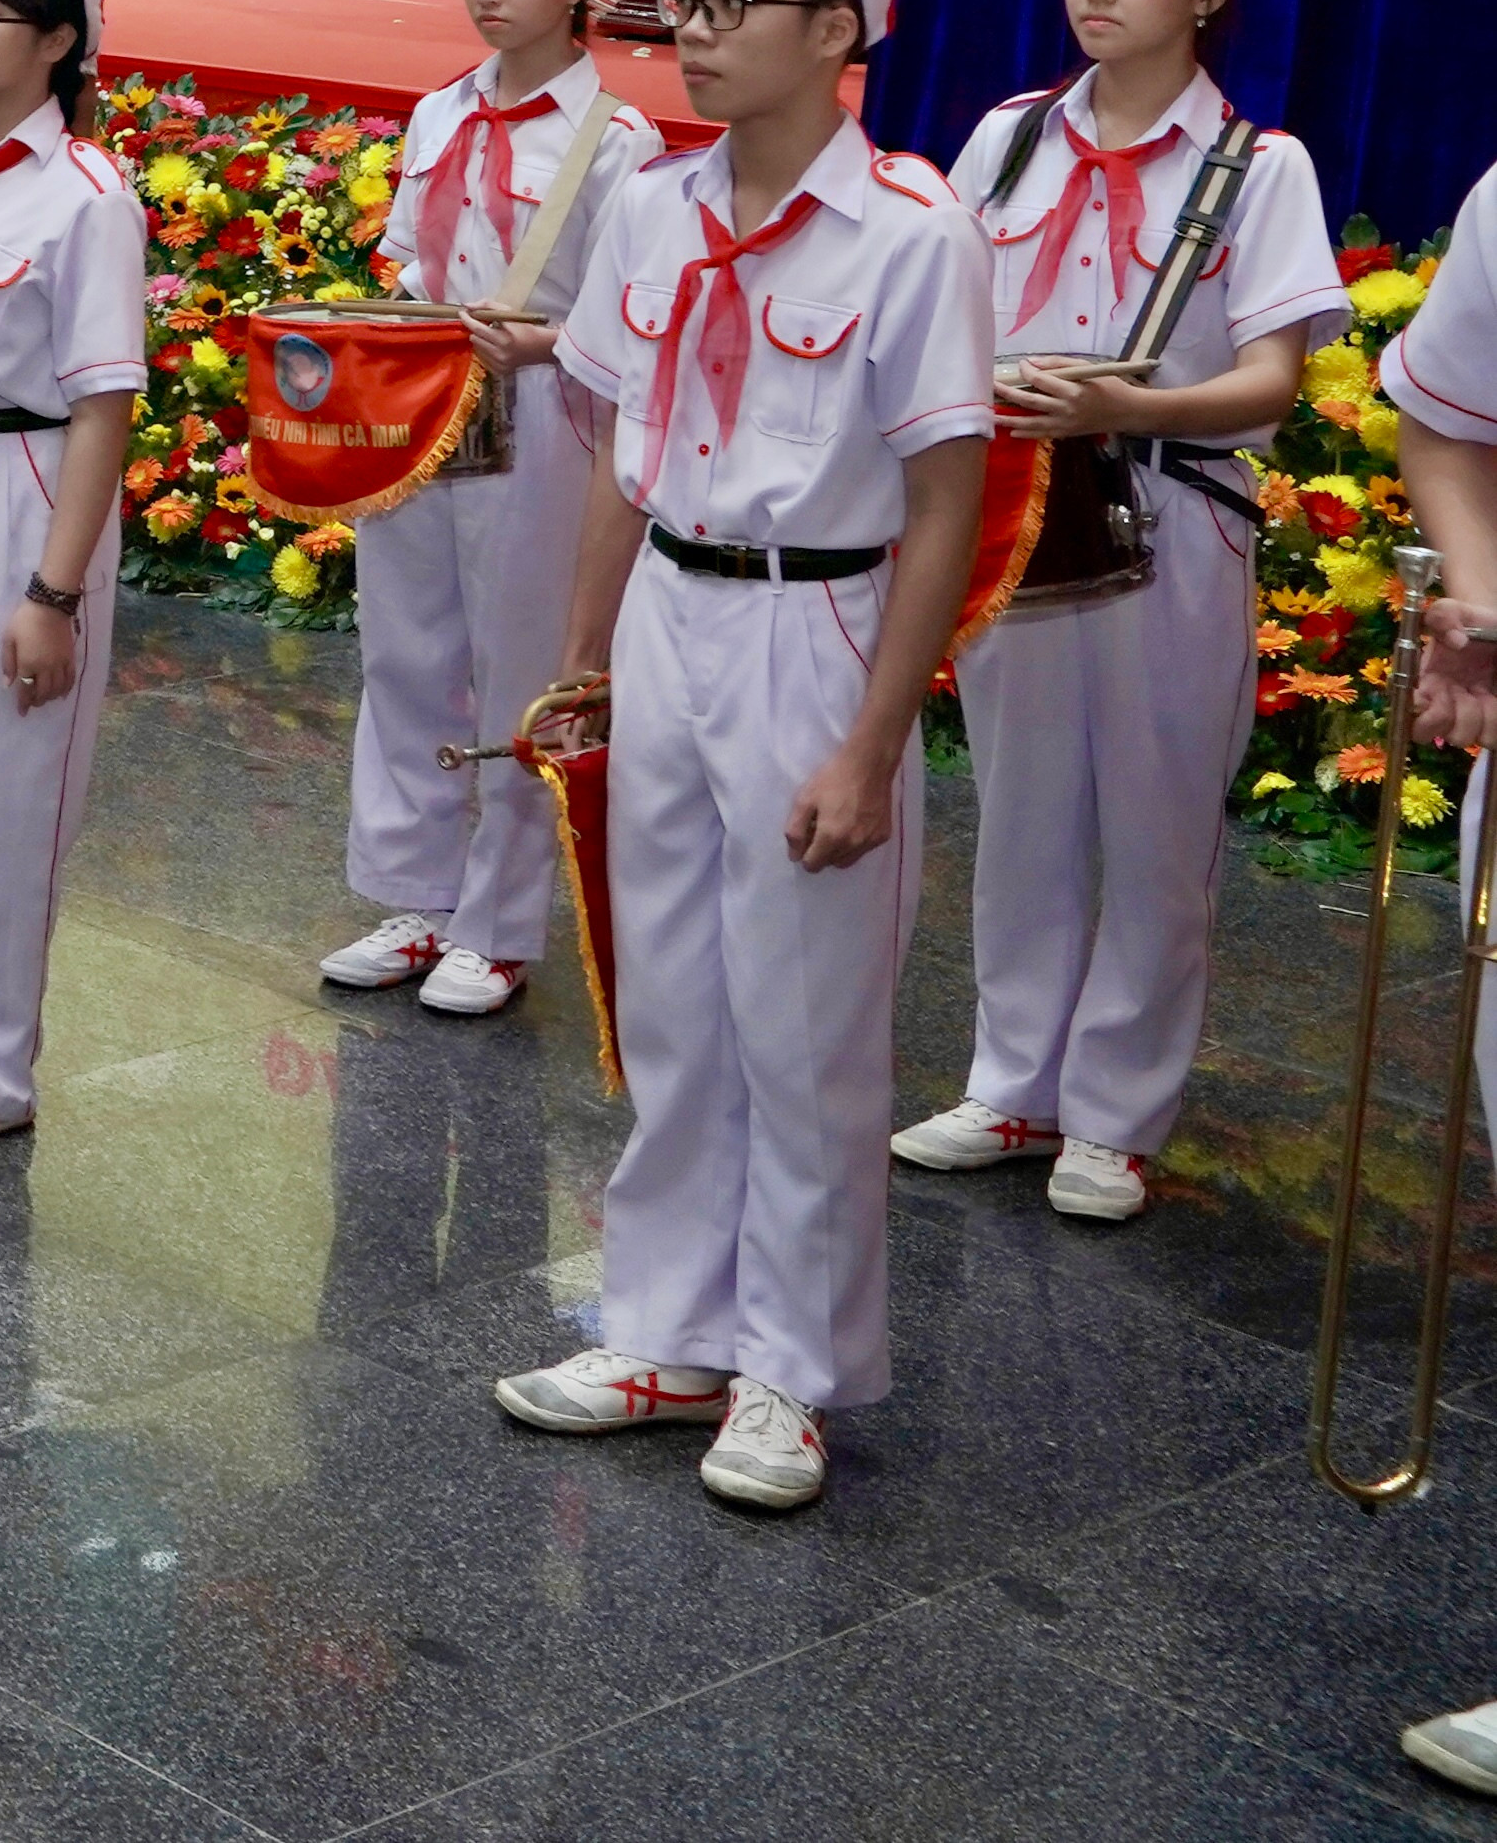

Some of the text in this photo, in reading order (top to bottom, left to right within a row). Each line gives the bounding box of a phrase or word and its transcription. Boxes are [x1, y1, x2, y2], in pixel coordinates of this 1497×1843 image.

[282, 420, 307, 445] NHI
[343, 419, 368, 447] CÀ
[370, 423, 410, 448] MAU
